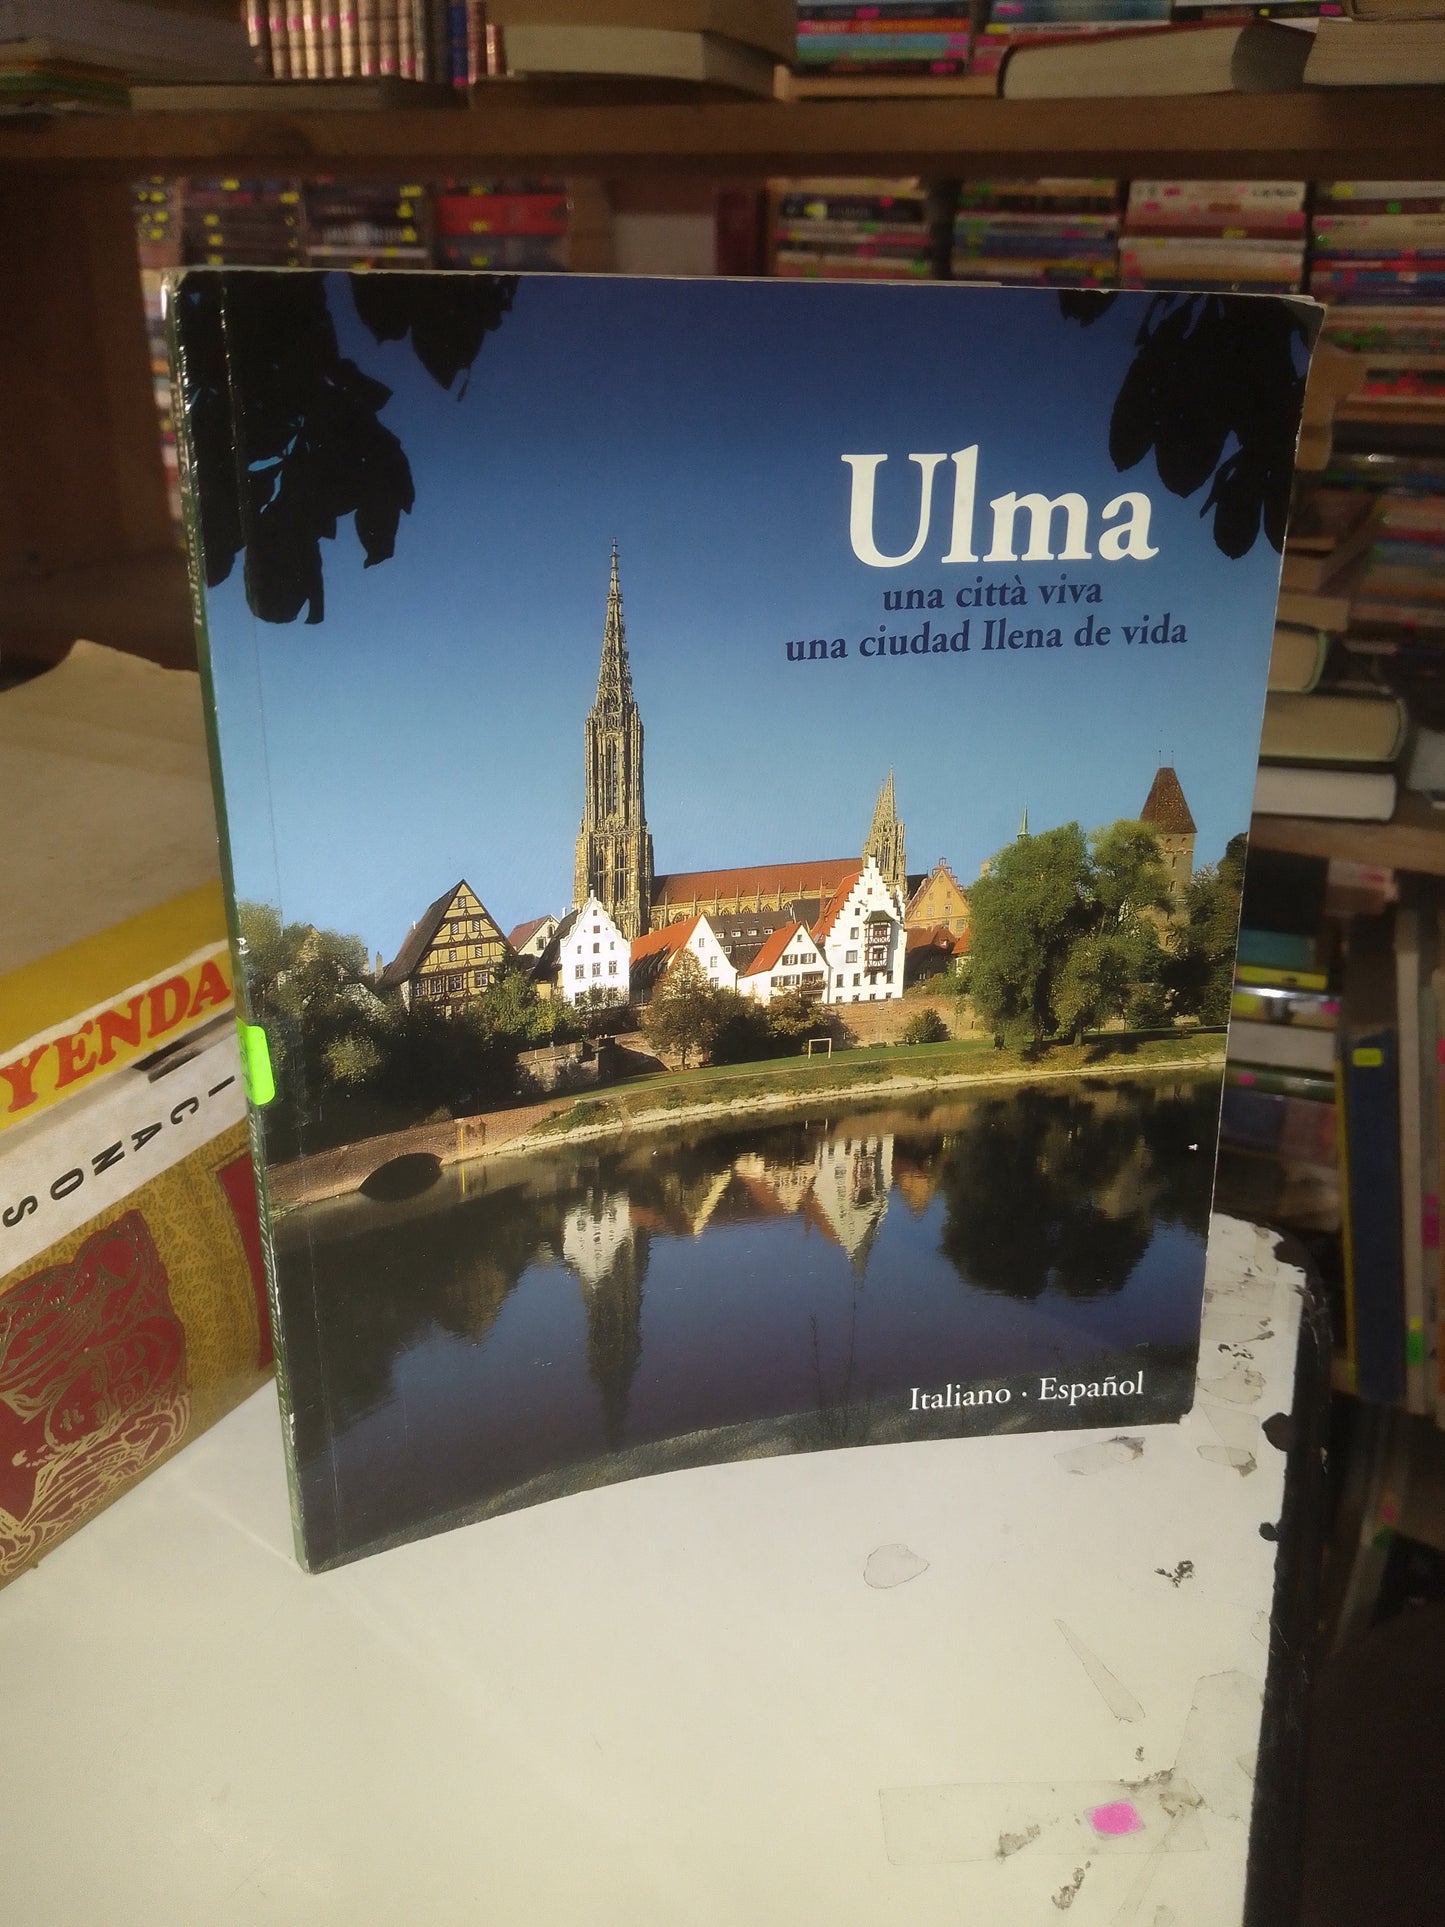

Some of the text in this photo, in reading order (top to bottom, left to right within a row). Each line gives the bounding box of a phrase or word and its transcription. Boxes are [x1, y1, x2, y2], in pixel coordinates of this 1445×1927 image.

[841, 444, 1159, 568] Ulma
[883, 573, 1103, 611] una città viva
[785, 635, 848, 662] una
[859, 619, 970, 657] ciudad
[1074, 614, 1111, 647] de
[1121, 612, 1188, 646] vida
[0, 959, 232, 1113] YENDA
[262, 1237, 275, 1304] ciudad
[909, 1383, 1012, 1411] Italiano
[1038, 1370, 1145, 1407] Español
